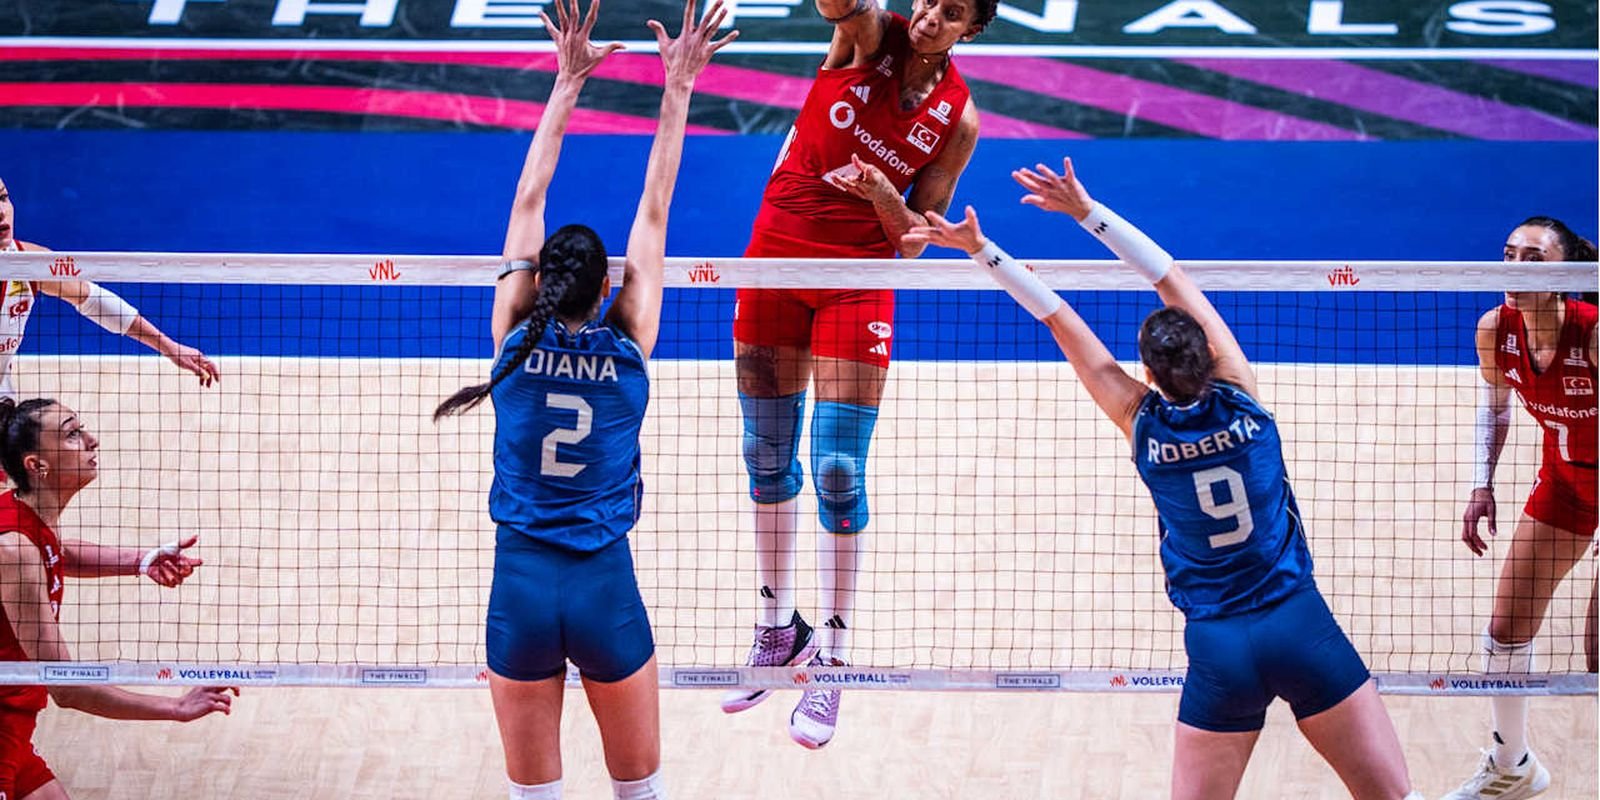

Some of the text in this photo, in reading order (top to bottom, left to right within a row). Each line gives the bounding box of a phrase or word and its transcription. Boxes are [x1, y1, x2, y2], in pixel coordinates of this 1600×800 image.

[700, 0, 1555, 35] FNALS
[854, 125, 915, 175] vodafone
[49, 256, 81, 276] VNL
[369, 259, 401, 280] VNL
[688, 262, 720, 283] VNL
[1328, 265, 1360, 286] VNL
[524, 349, 618, 382] DIANA
[1528, 401, 1598, 419] vodafone
[540, 393, 593, 477] 2
[1148, 415, 1261, 464] ROBERTA
[1192, 465, 1254, 549] 9
[71, 670, 101, 678] FINALS
[179, 670, 251, 679] VOLLEYBALL
[701, 675, 732, 683] FINALS
[814, 674, 886, 683] VOLLEYBALL
[1132, 676, 1184, 686] VOLLEYB
[1451, 680, 1524, 689] VOLLEYBALL
